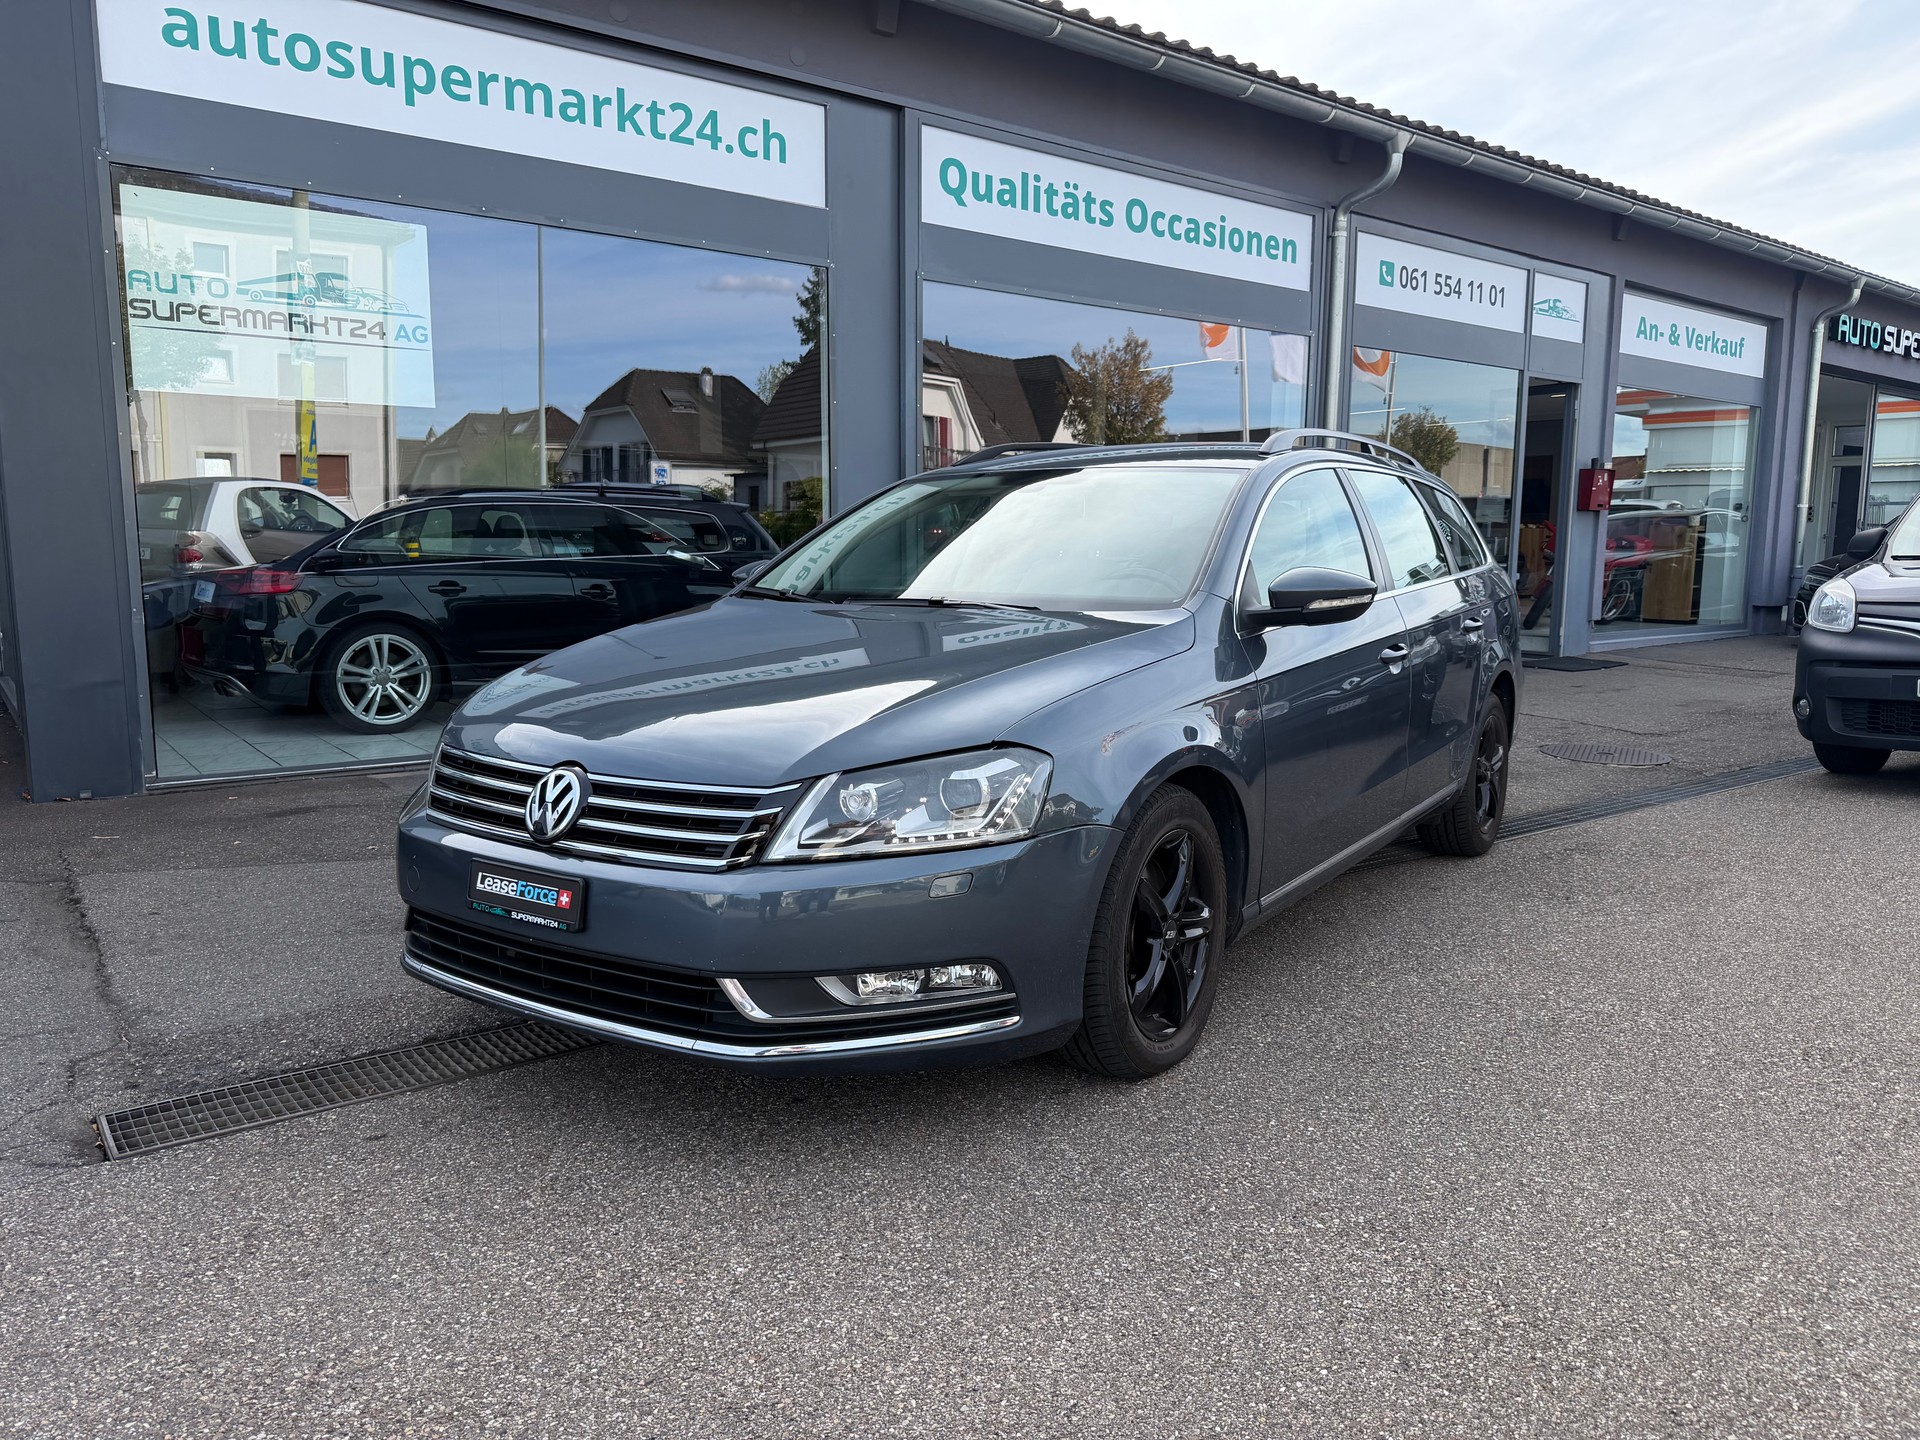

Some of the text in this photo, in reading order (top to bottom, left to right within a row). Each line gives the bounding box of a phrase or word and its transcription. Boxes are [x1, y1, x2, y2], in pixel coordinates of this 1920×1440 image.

[162, 7, 787, 164] autosupermarkt24.ch
[939, 157, 1298, 264] Qualitäts Occasionen
[127, 269, 230, 299] AUTO
[1400, 265, 1505, 308] 061 554 11 01
[129, 298, 430, 345] SUPERMARKT24 AG
[1636, 316, 1746, 358] An- & Verkauf
[1837, 313, 1920, 359] AUTO SUPE
[476, 871, 559, 905] LeaseForce
[472, 902, 490, 913] AUTO
[511, 911, 559, 929] SUPERMARKT24
